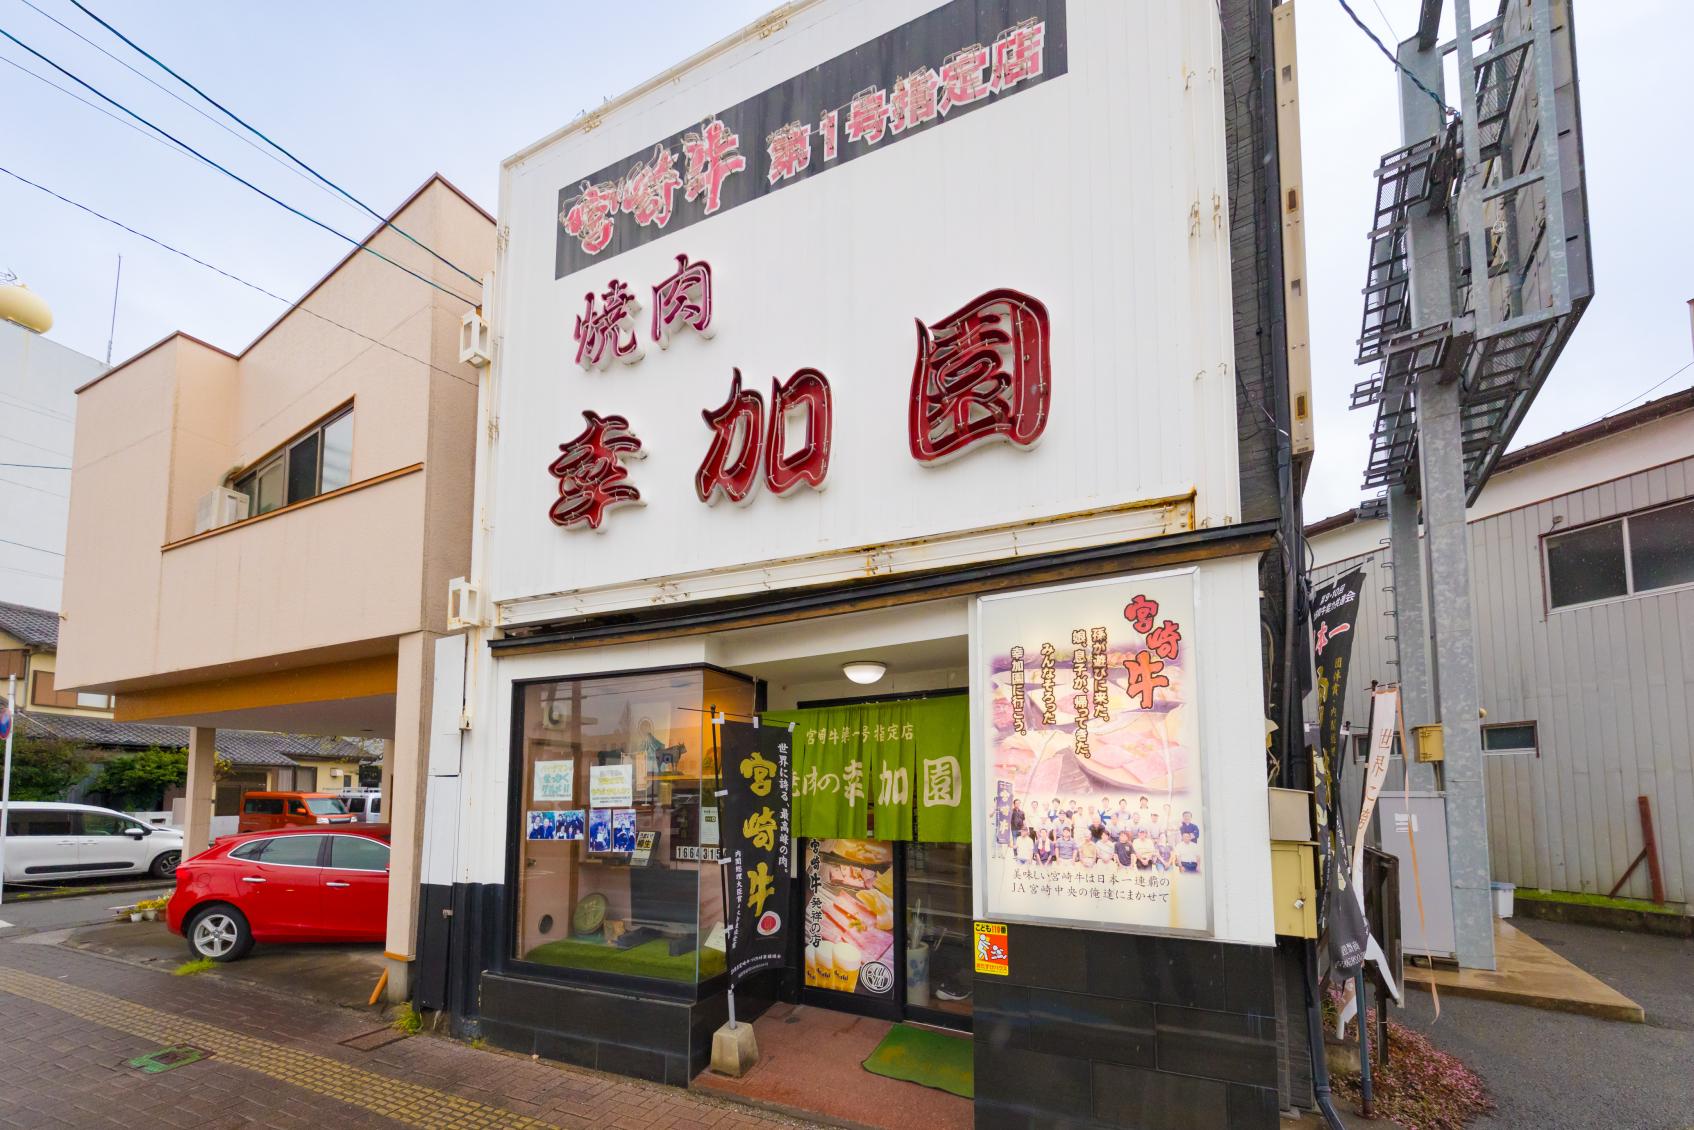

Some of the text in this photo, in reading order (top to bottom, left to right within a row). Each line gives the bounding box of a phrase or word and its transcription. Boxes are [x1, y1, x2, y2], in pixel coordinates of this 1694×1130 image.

[560, 17, 1045, 254] 宮崎牛 第1号指定店
[574, 253, 716, 371] 焼肉
[1040, 642, 1056, 725] みんなそろった
[1123, 594, 1181, 709] 宮崎牛
[740, 752, 777, 917] 宮崎牛
